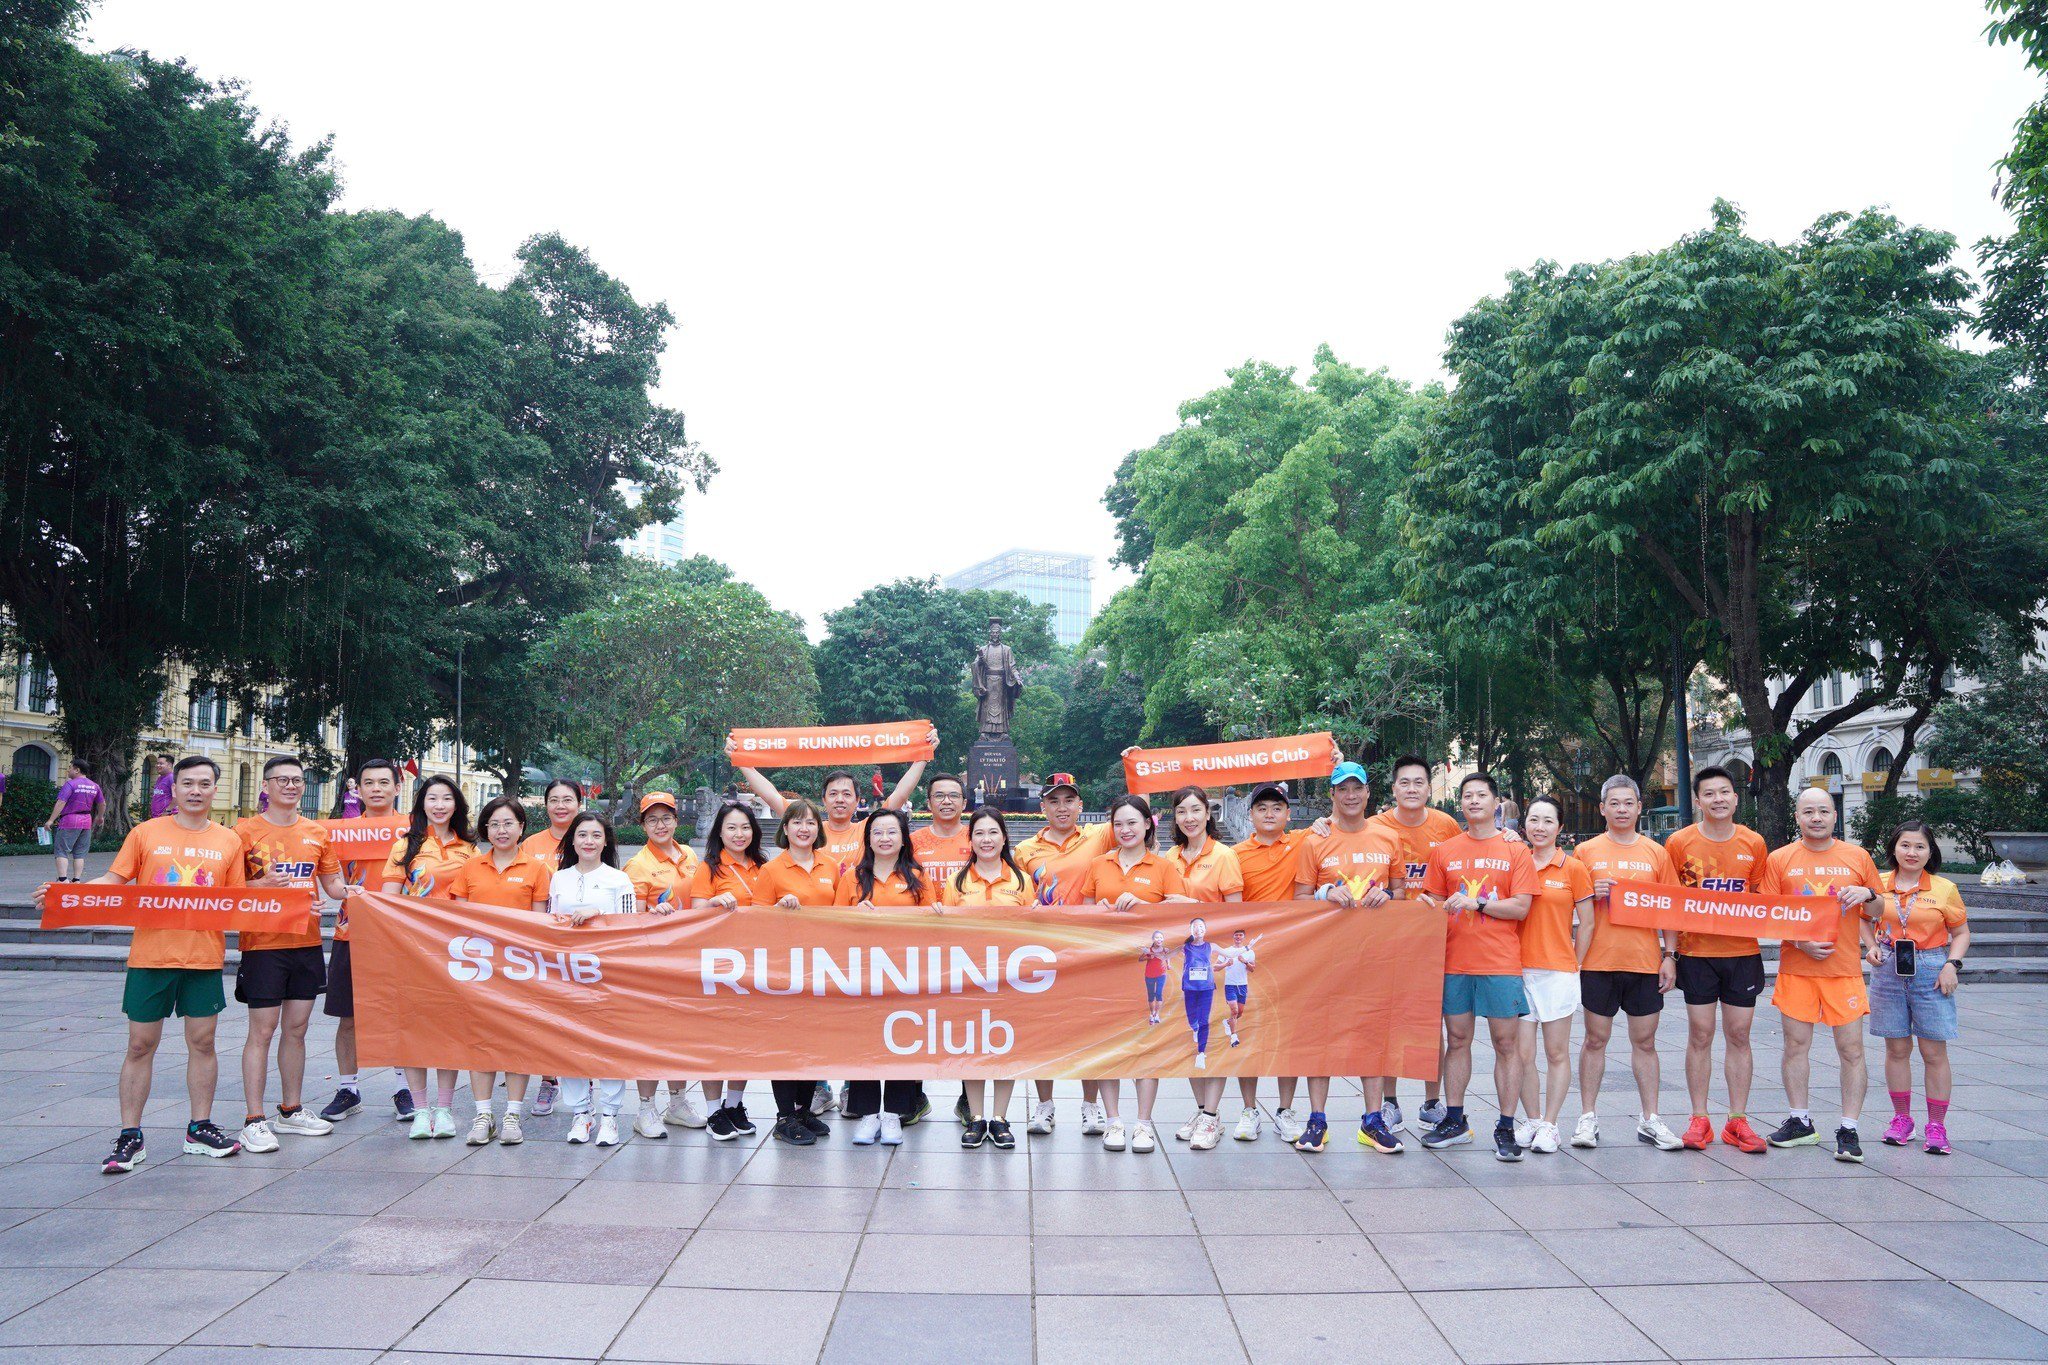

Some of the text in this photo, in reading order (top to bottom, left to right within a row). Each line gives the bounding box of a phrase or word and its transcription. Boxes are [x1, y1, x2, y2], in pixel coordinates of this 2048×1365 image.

[759, 732, 910, 750] SHB RUNNING Club
[1151, 746, 1310, 775] SHB RUNNING Club
[330, 827, 391, 842] UNNING
[197, 848, 222, 861] SHB
[840, 841, 860, 853] SHB
[1365, 852, 1390, 865] SHB
[1484, 857, 1510, 872] SHB
[1629, 860, 1652, 872] SHB
[1826, 867, 1850, 876] SHB
[1702, 878, 1746, 893] SHB
[82, 895, 282, 914] SHB RUNNING Club
[1640, 893, 1812, 922] SHB RUNNING Club
[503, 944, 1059, 997] SHB RUNNING
[883, 1008, 1016, 1056] Club
